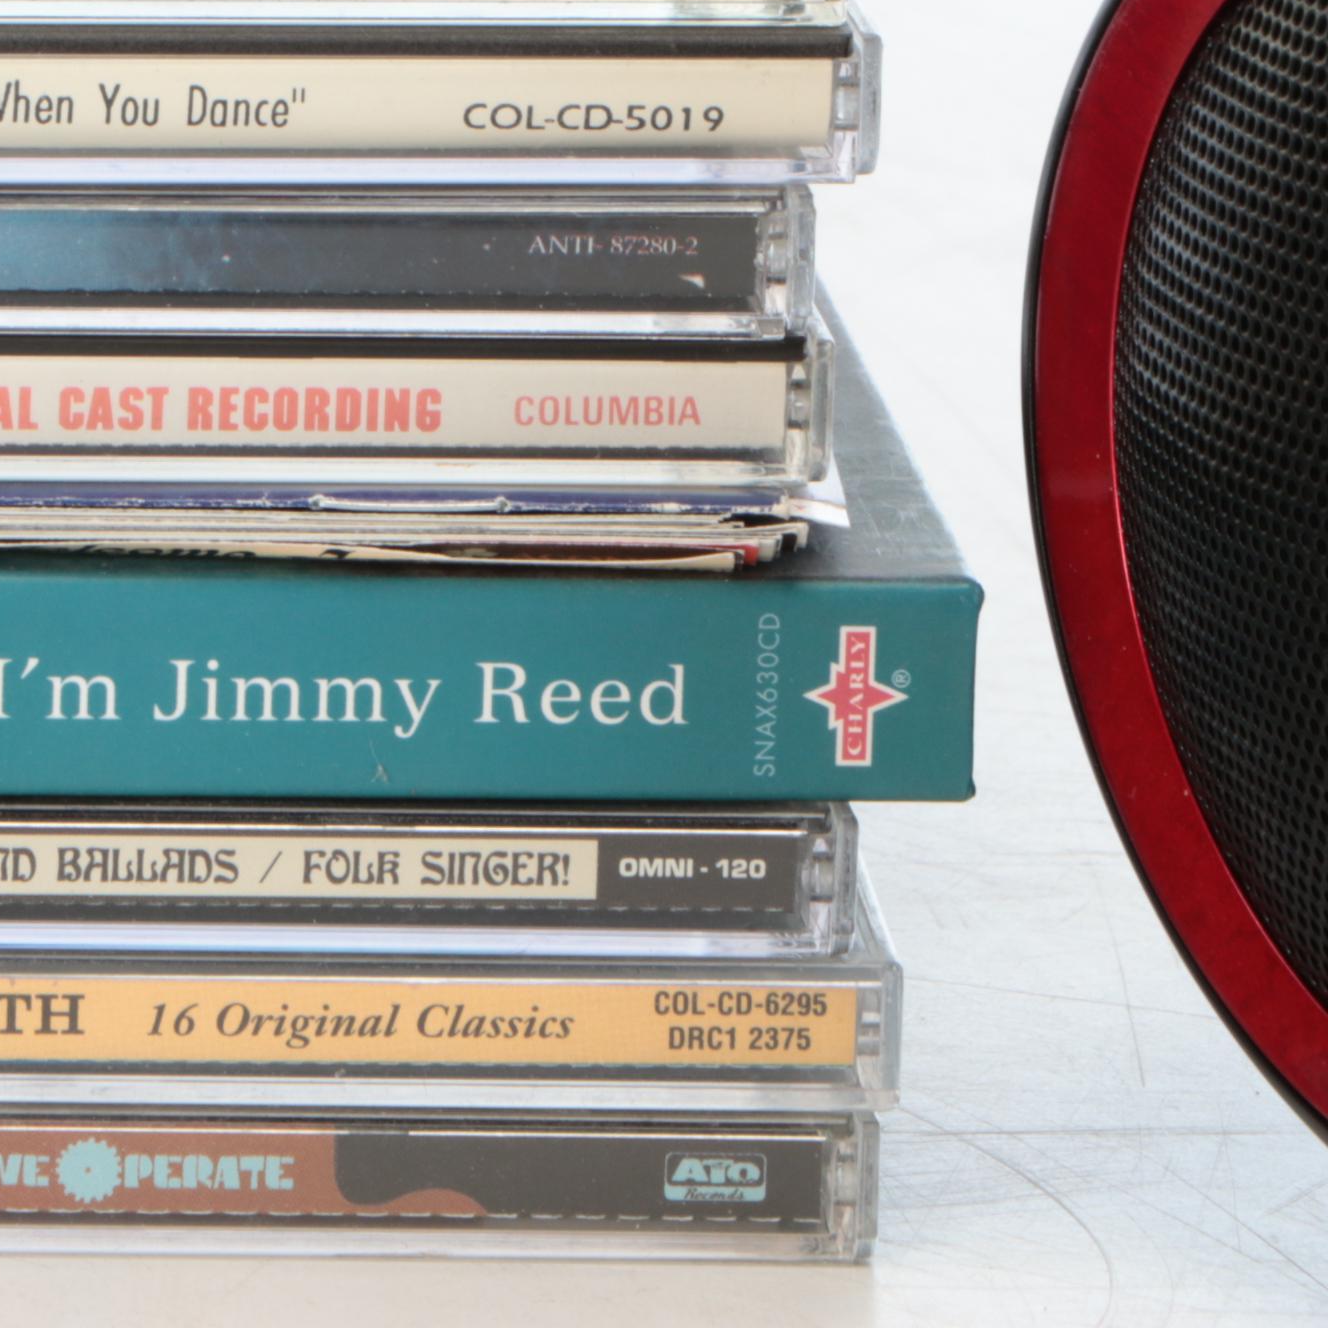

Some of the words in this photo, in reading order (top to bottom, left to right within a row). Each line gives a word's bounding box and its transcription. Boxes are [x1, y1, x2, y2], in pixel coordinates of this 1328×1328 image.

[99, 84, 159, 127] You
[187, 84, 305, 128] Dance"
[464, 103, 724, 132] COL-CD-5019
[610, 235, 698, 255] 87280-2
[59, 387, 170, 431] CAST
[187, 387, 442, 432] RECORDING
[515, 395, 701, 426] COLUMBIA
[154, 659, 440, 738] Jimmy
[475, 662, 686, 725] Reed
[753, 613, 780, 776] SNAX630CD
[847, 636, 866, 756] CHARLY
[57, 847, 239, 883] BALLADS
[303, 849, 400, 884] FOLK
[421, 851, 570, 886] SINGER!
[619, 857, 693, 877] OMNI
[716, 859, 766, 879] 120
[149, 1003, 197, 1035] 16
[217, 1002, 400, 1048] Original
[417, 1004, 574, 1039] Classics
[655, 990, 827, 1016] COL-CD-6295
[669, 1025, 736, 1050] DRC1
[749, 1026, 811, 1051] 2375
[673, 1159, 759, 1186] ATO
